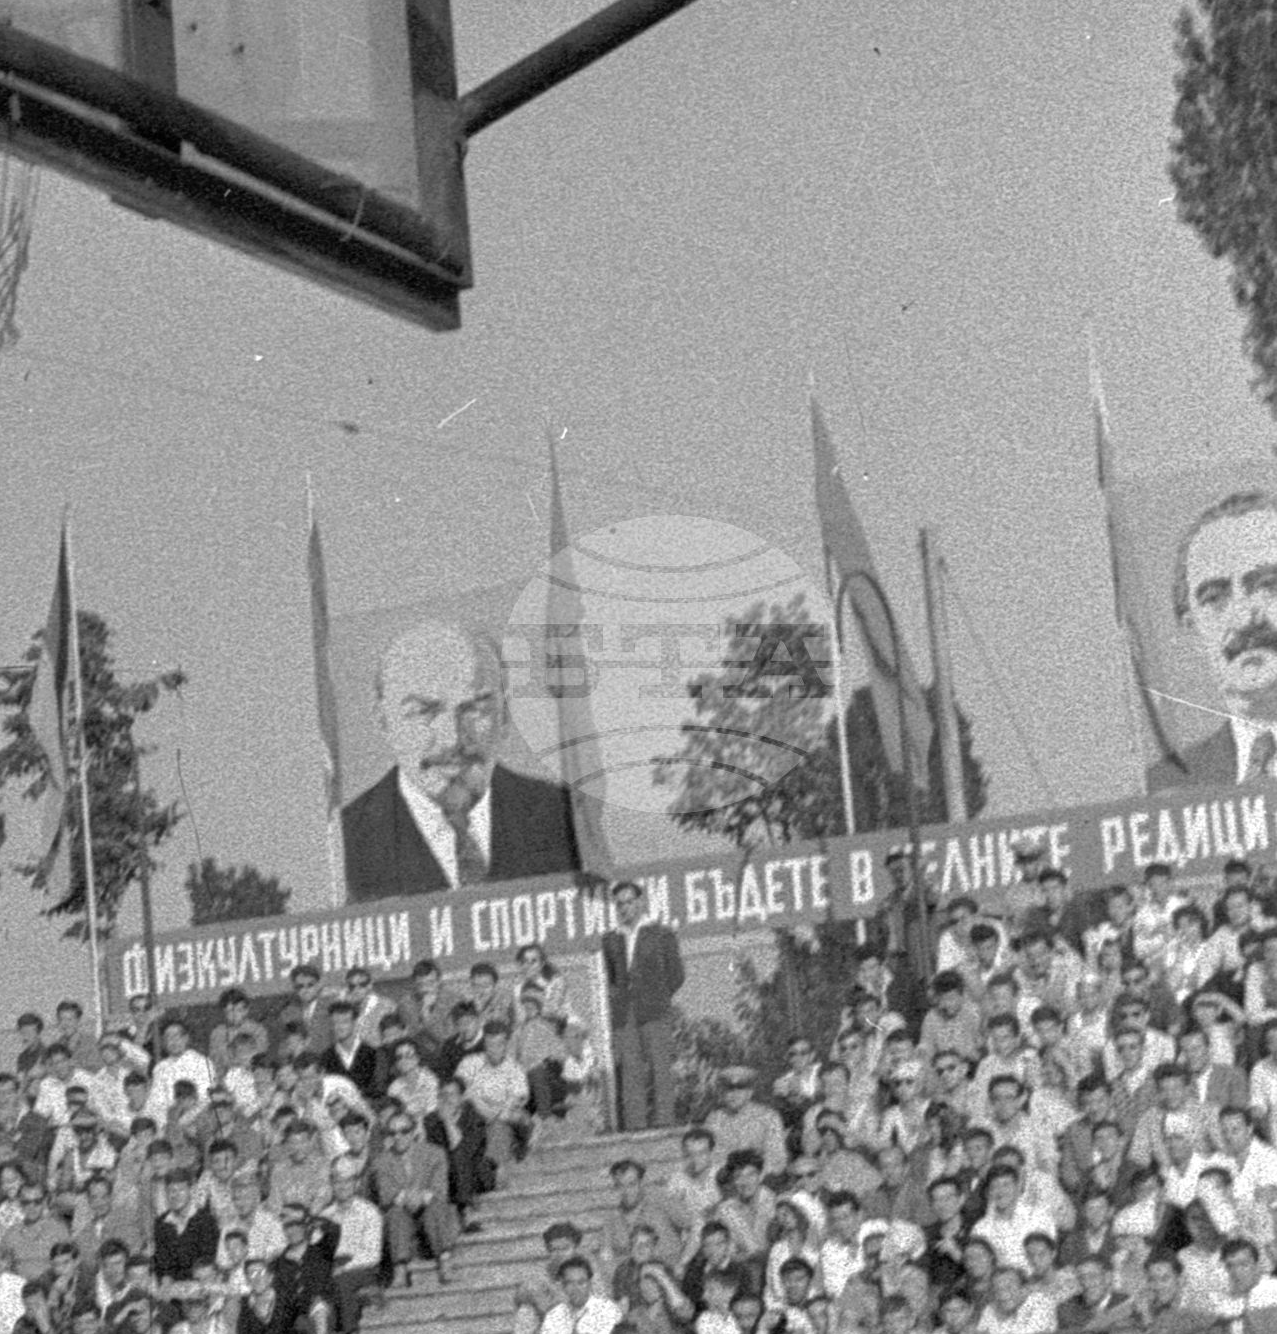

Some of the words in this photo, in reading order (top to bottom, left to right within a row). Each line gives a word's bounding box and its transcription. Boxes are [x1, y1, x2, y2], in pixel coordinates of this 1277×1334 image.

[428, 904, 453, 959] И
[684, 854, 829, 924] БЪДЕТЕ
[849, 849, 874, 904] В
[1099, 794, 1269, 874] РЕДИЦИ
